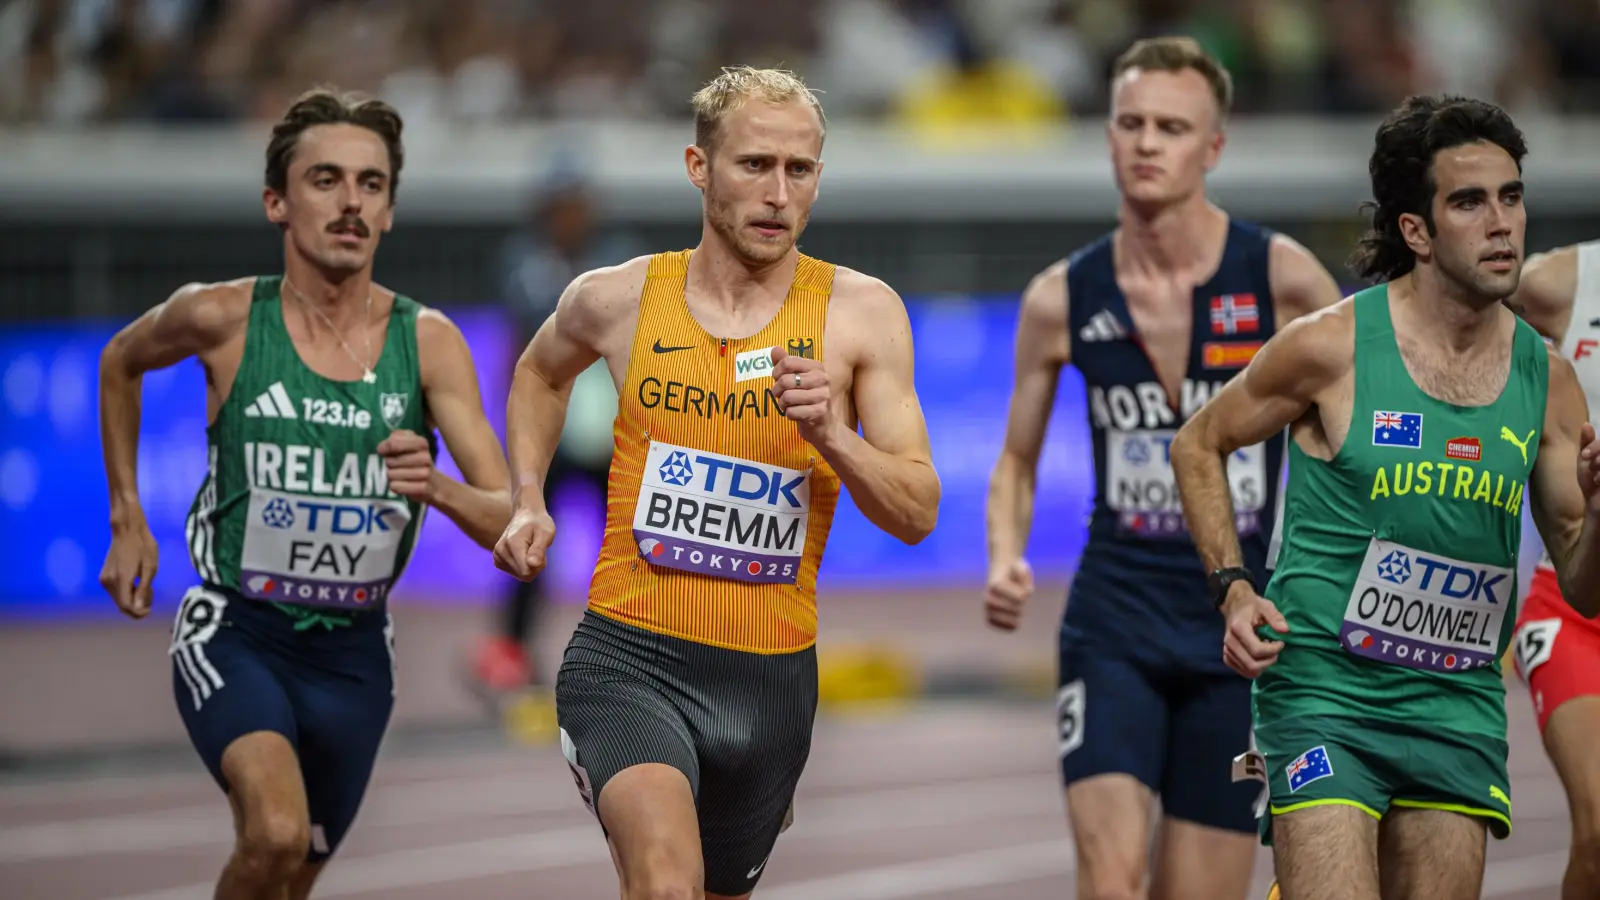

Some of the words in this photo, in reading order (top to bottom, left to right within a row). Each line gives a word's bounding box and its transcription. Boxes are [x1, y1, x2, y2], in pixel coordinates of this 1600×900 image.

[302, 397, 372, 429] 123.ie
[638, 377, 787, 421] GERMAN
[1090, 378, 1223, 431] NORW
[244, 442, 399, 498] IRELAN
[1448, 442, 1480, 454] CHEMIST
[695, 455, 806, 508] TDK
[1370, 461, 1524, 517] AUSTRALIA
[296, 501, 397, 535] TDK
[646, 492, 800, 551] BREMM
[288, 541, 367, 577] FAY
[1415, 557, 1508, 604] TDK
[174, 597, 215, 642] 19
[1357, 587, 1492, 647] O'DONNELL
